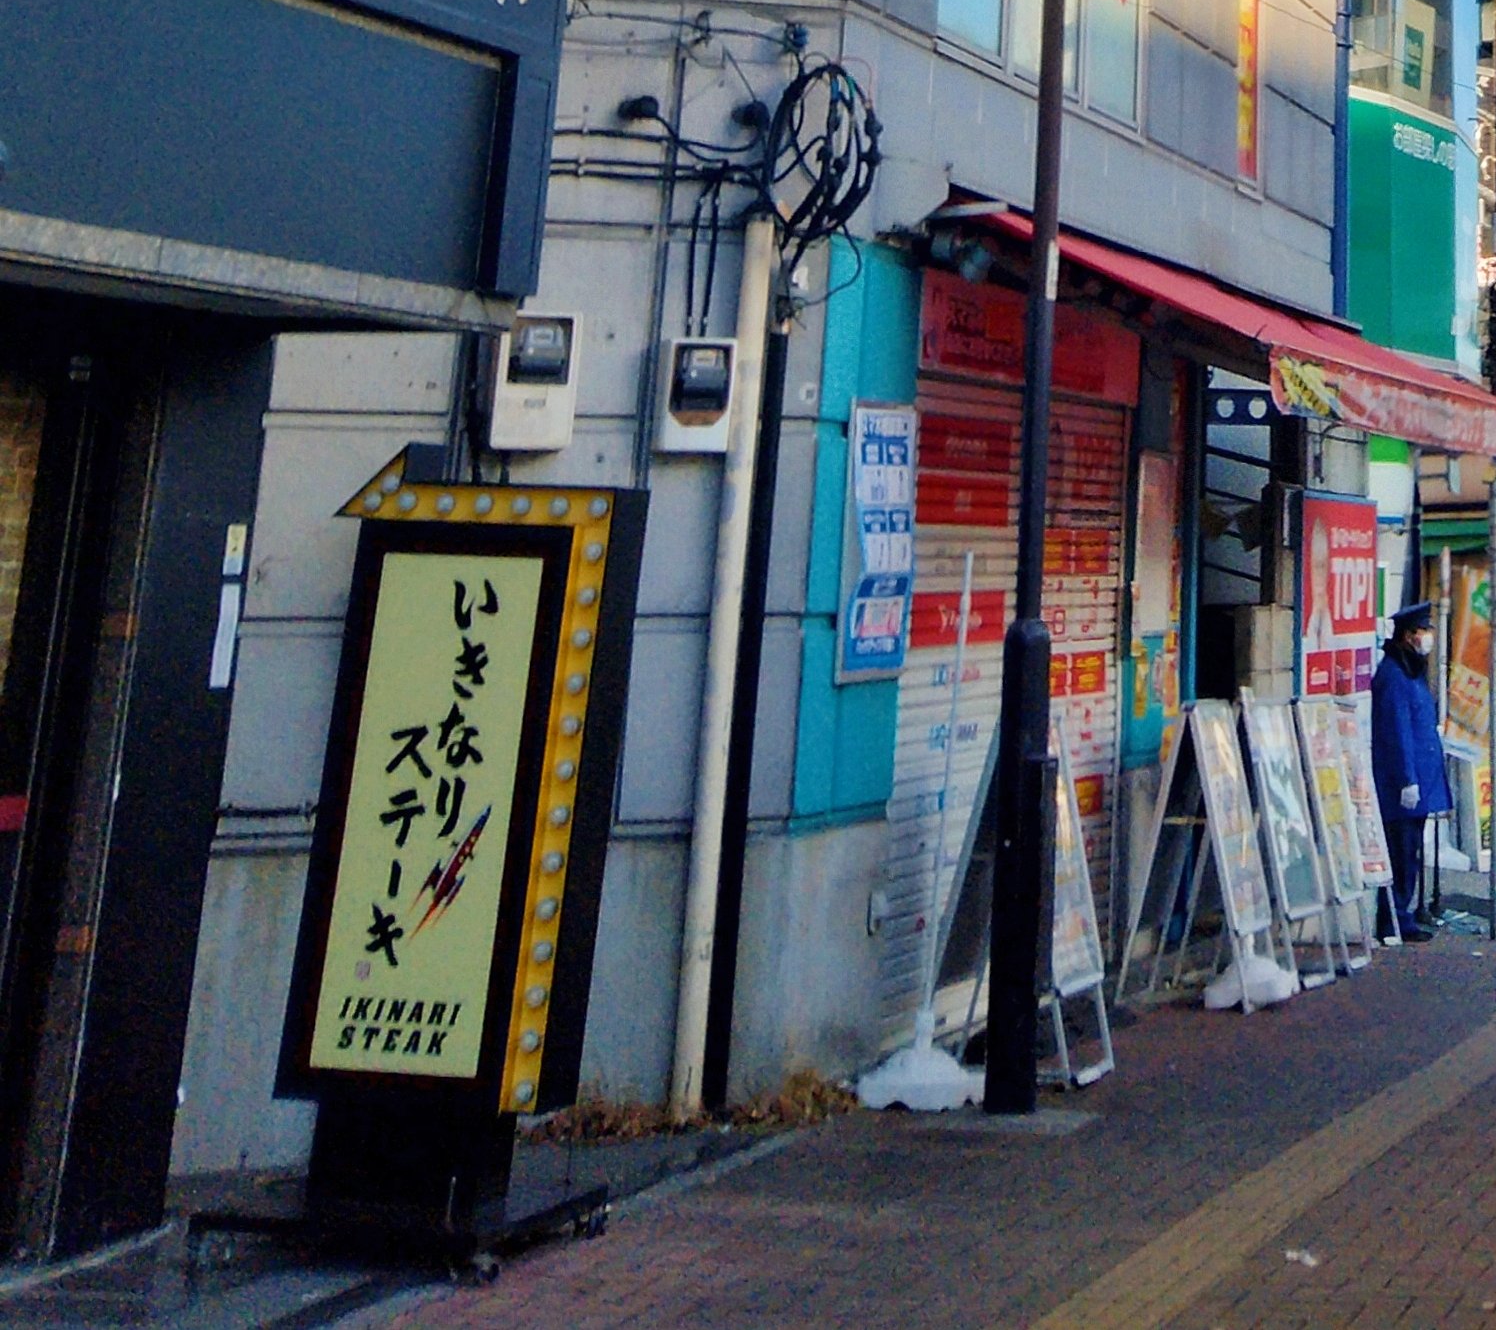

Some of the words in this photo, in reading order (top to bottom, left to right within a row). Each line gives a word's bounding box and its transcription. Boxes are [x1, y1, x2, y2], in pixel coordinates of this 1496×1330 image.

[435, 578, 500, 839] いきなり
[365, 725, 432, 968] ステーキ
[336, 1026, 450, 1058] STEAK
[337, 995, 463, 1029] IKINARI
